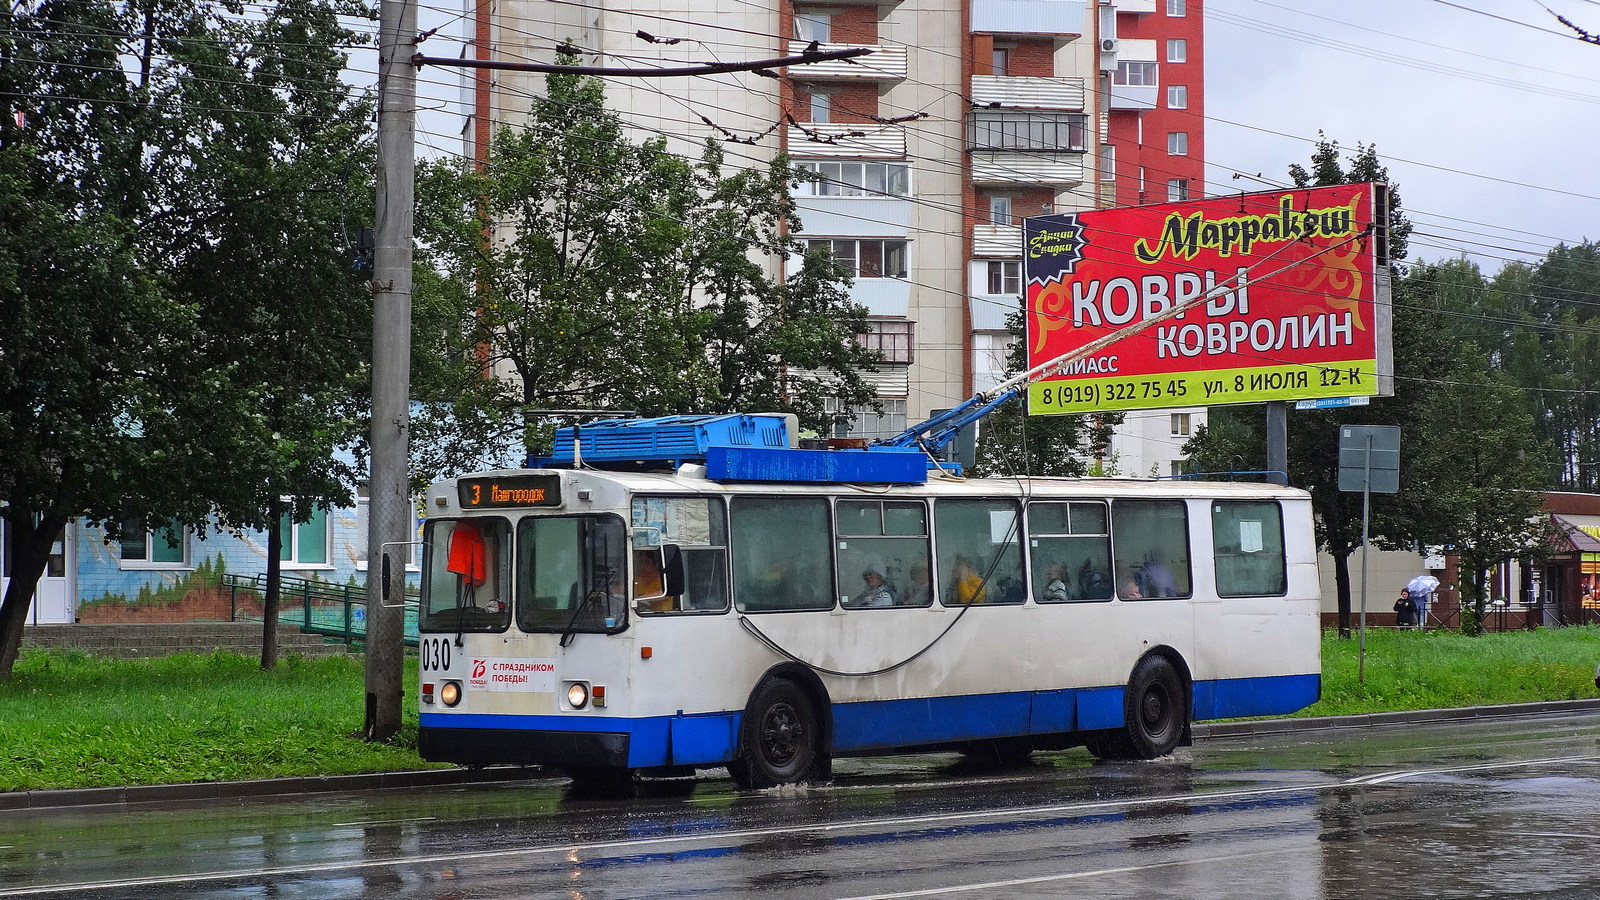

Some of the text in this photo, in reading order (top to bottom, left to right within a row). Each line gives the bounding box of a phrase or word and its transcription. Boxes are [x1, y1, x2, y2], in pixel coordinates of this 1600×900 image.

[1030, 230, 1073, 245] Акции
[1135, 195, 1353, 263] Марракеш
[1030, 243, 1072, 258] Скидки
[1072, 266, 1249, 328] КОВРЫ
[1158, 312, 1353, 359] КОВРОЛИН
[1058, 355, 1118, 376] МИАСС
[1043, 368, 1361, 407] 8 (919) 322 75 45 ул. 8 ИЮЛЯ 12-К
[471, 484, 481, 504] 3
[423, 638, 450, 671] 030
[499, 663, 554, 672] ПРАЗДНИКОМ
[492, 674, 528, 683] ПОБЕДЫ!
